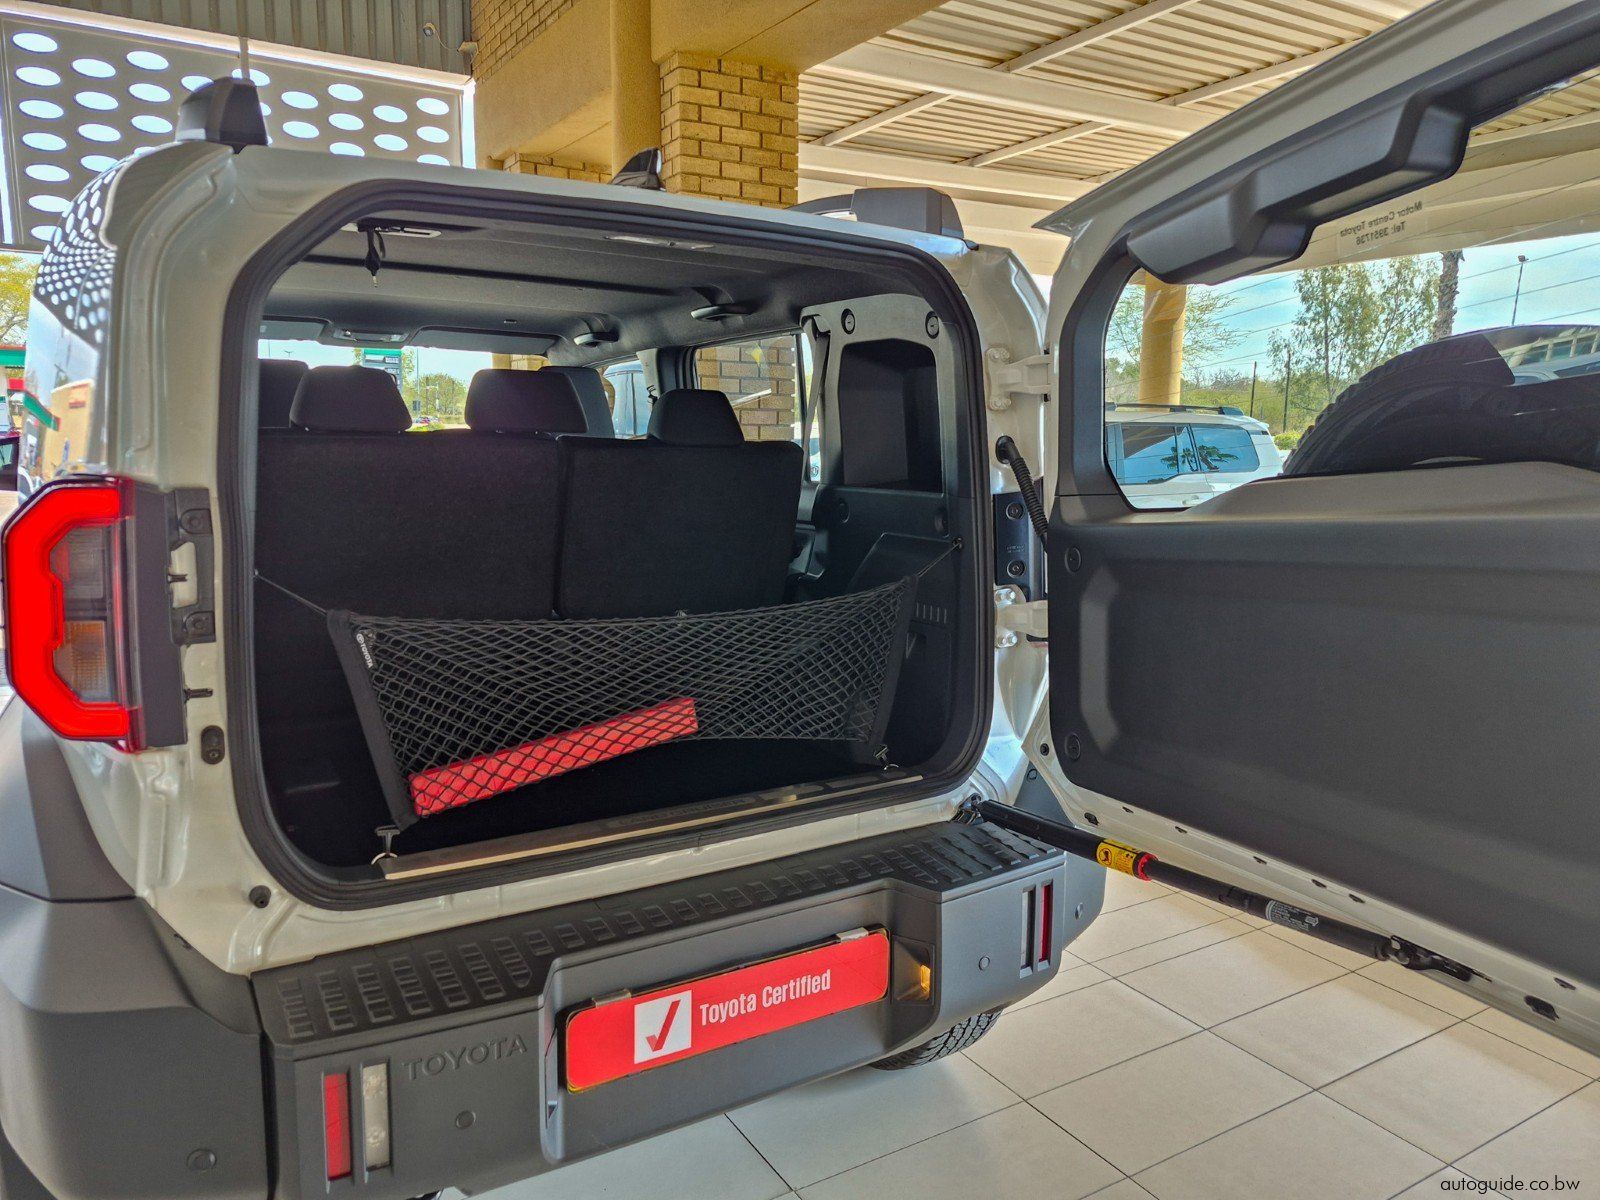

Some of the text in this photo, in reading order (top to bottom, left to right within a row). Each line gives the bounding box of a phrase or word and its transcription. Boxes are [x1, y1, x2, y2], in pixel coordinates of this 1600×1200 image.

[360, 643, 374, 669] TOYOTA
[700, 969, 832, 1026] Toyota Certified
[401, 1034, 528, 1081] TOYOTA
